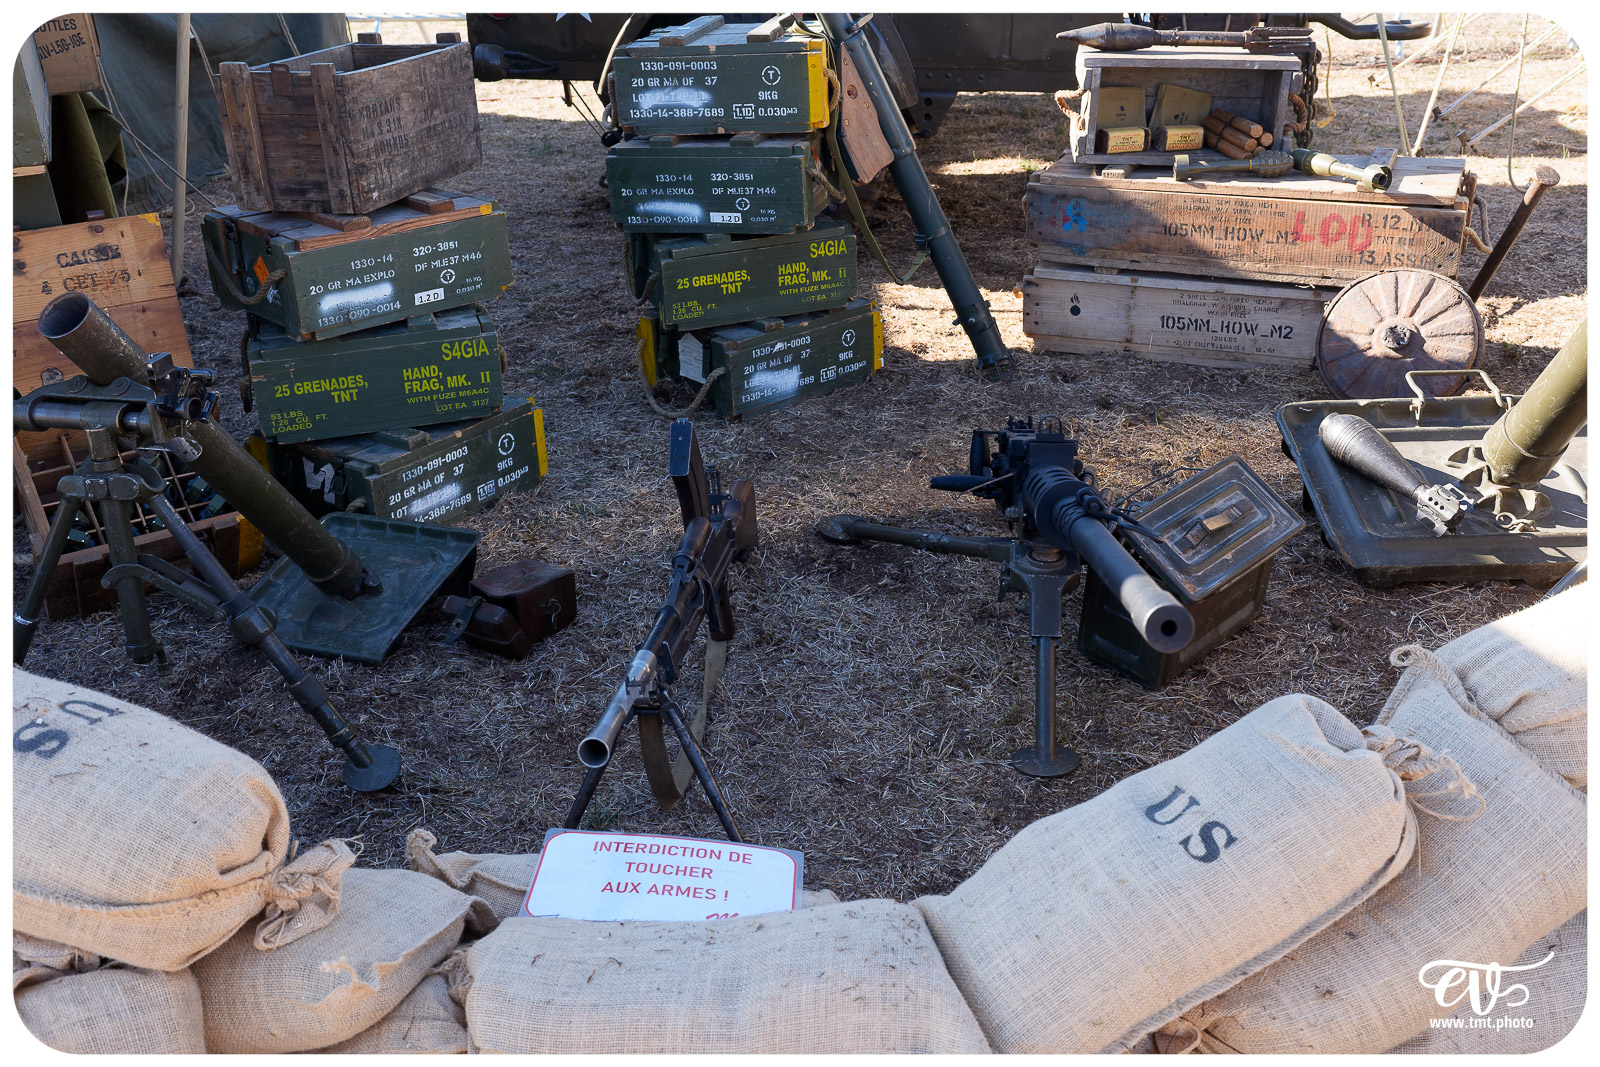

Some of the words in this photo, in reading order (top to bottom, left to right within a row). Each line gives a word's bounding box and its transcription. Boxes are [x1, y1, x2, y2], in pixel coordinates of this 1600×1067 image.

[640, 60, 718, 71] 1330-091-0003
[632, 78, 644, 87] 20
[647, 78, 660, 86] GR
[664, 77, 678, 86] MA
[682, 76, 694, 86] OF
[704, 76, 718, 86] 37
[758, 90, 778, 100] 9KG
[630, 108, 724, 118] 1330-14-388-7689
[710, 173, 754, 181] 320-3851
[621, 188, 632, 196] 20
[636, 188, 648, 196] GR
[667, 187, 694, 196] EXPLO
[712, 187, 724, 195] DF
[757, 187, 776, 195] M46
[1376, 236, 1395, 245] TNT
[412, 240, 459, 257] 320-3851
[415, 262, 428, 272] DF
[462, 251, 482, 263] M46
[778, 262, 809, 275] HAND,
[309, 285, 324, 296] 20
[328, 280, 341, 291] GR
[345, 276, 362, 287] MA
[364, 269, 395, 284] EXPLO
[677, 279, 689, 290] 25
[692, 270, 750, 287] GRENADES,
[778, 273, 809, 286] FRAG,
[812, 270, 831, 282] MK.
[721, 282, 742, 295] TNT
[800, 285, 819, 293] FUZE
[419, 294, 431, 303] 1.2
[752, 336, 811, 358] 1330-91-0003
[744, 365, 754, 375] 20
[757, 361, 767, 371] GR
[769, 358, 781, 368] MA
[784, 354, 794, 364] OF
[801, 348, 811, 359] 37
[839, 350, 853, 361] 9KG
[403, 365, 442, 380] HAND,
[274, 383, 290, 398] 25
[294, 374, 369, 395] GRENADES,
[404, 378, 444, 394] FRAG,
[447, 374, 471, 388] MK.
[480, 371, 492, 384] II
[331, 389, 359, 403] TNT
[406, 396, 430, 404] WITH
[433, 392, 456, 400] FUZE
[459, 388, 489, 397] M6A4C
[284, 410, 306, 419] LBS.
[436, 404, 453, 412] LOT
[271, 419, 288, 427] 1.28
[296, 416, 311, 424] CU.
[272, 422, 312, 433] LOADED
[402, 446, 468, 482] 1330-091-0003
[497, 457, 513, 471] 9KG
[389, 492, 402, 506] 20
[404, 486, 416, 499] GR
[418, 479, 432, 492] MA
[434, 472, 445, 484] OF
[453, 463, 464, 476] 37
[1144, 785, 1238, 864] US
[593, 840, 722, 860] INTERDICTION
[728, 852, 753, 865] DE
[625, 861, 713, 879] TOUCHER
[600, 882, 642, 894] AUX
[647, 883, 717, 900] ARMES
[723, 890, 729, 901] !
